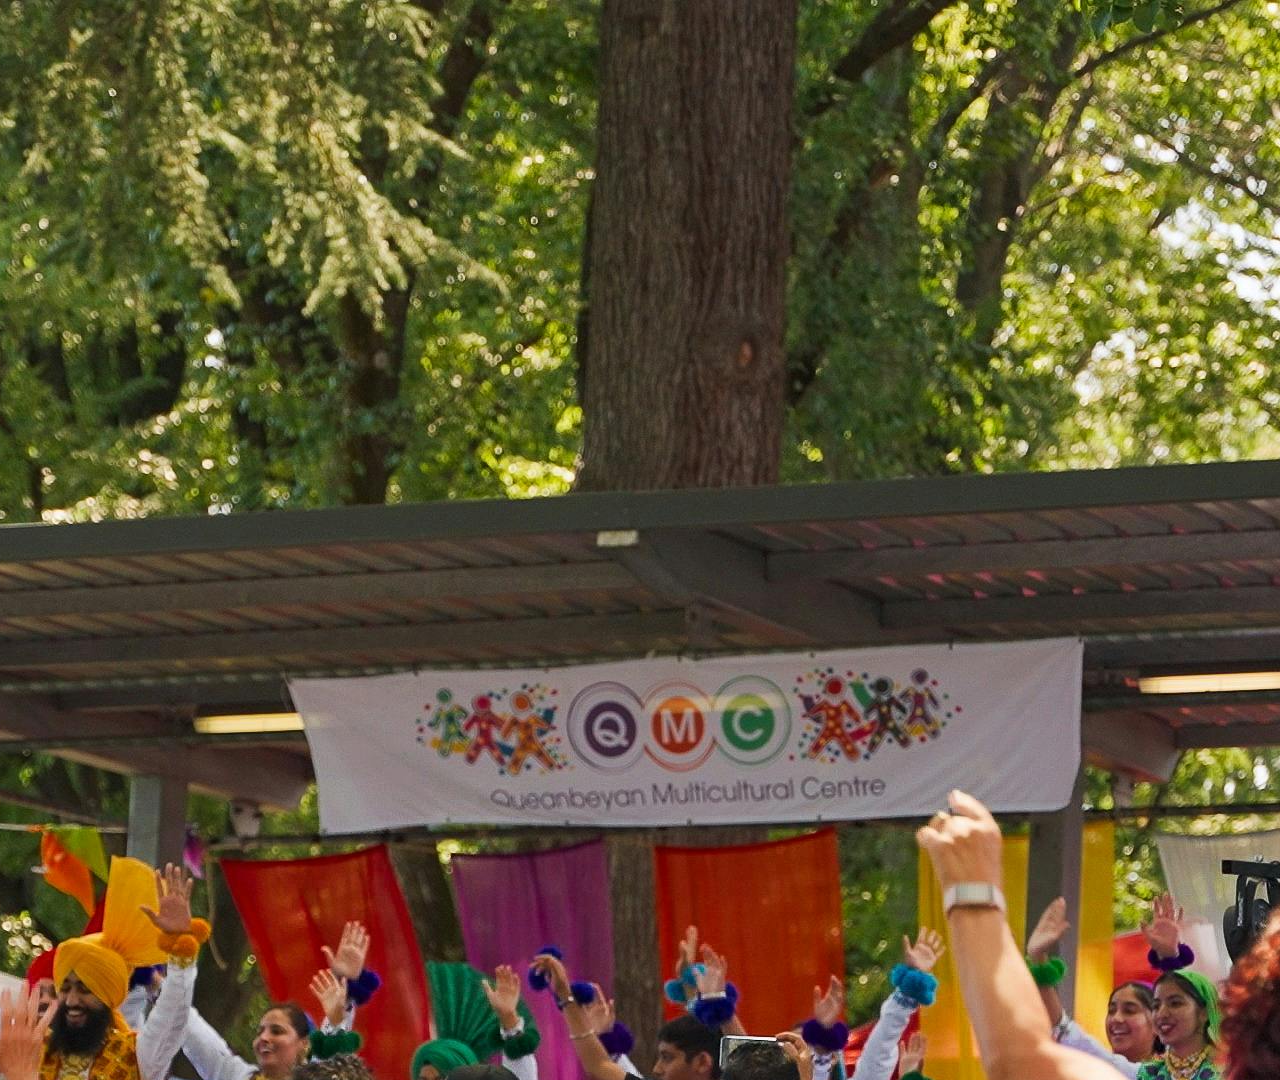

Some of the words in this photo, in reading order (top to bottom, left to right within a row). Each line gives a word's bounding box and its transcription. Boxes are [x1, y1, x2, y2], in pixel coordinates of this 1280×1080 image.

[490, 786, 645, 812] Queanbeyan
[651, 777, 794, 804] Multicultural
[801, 776, 887, 800] Centre
